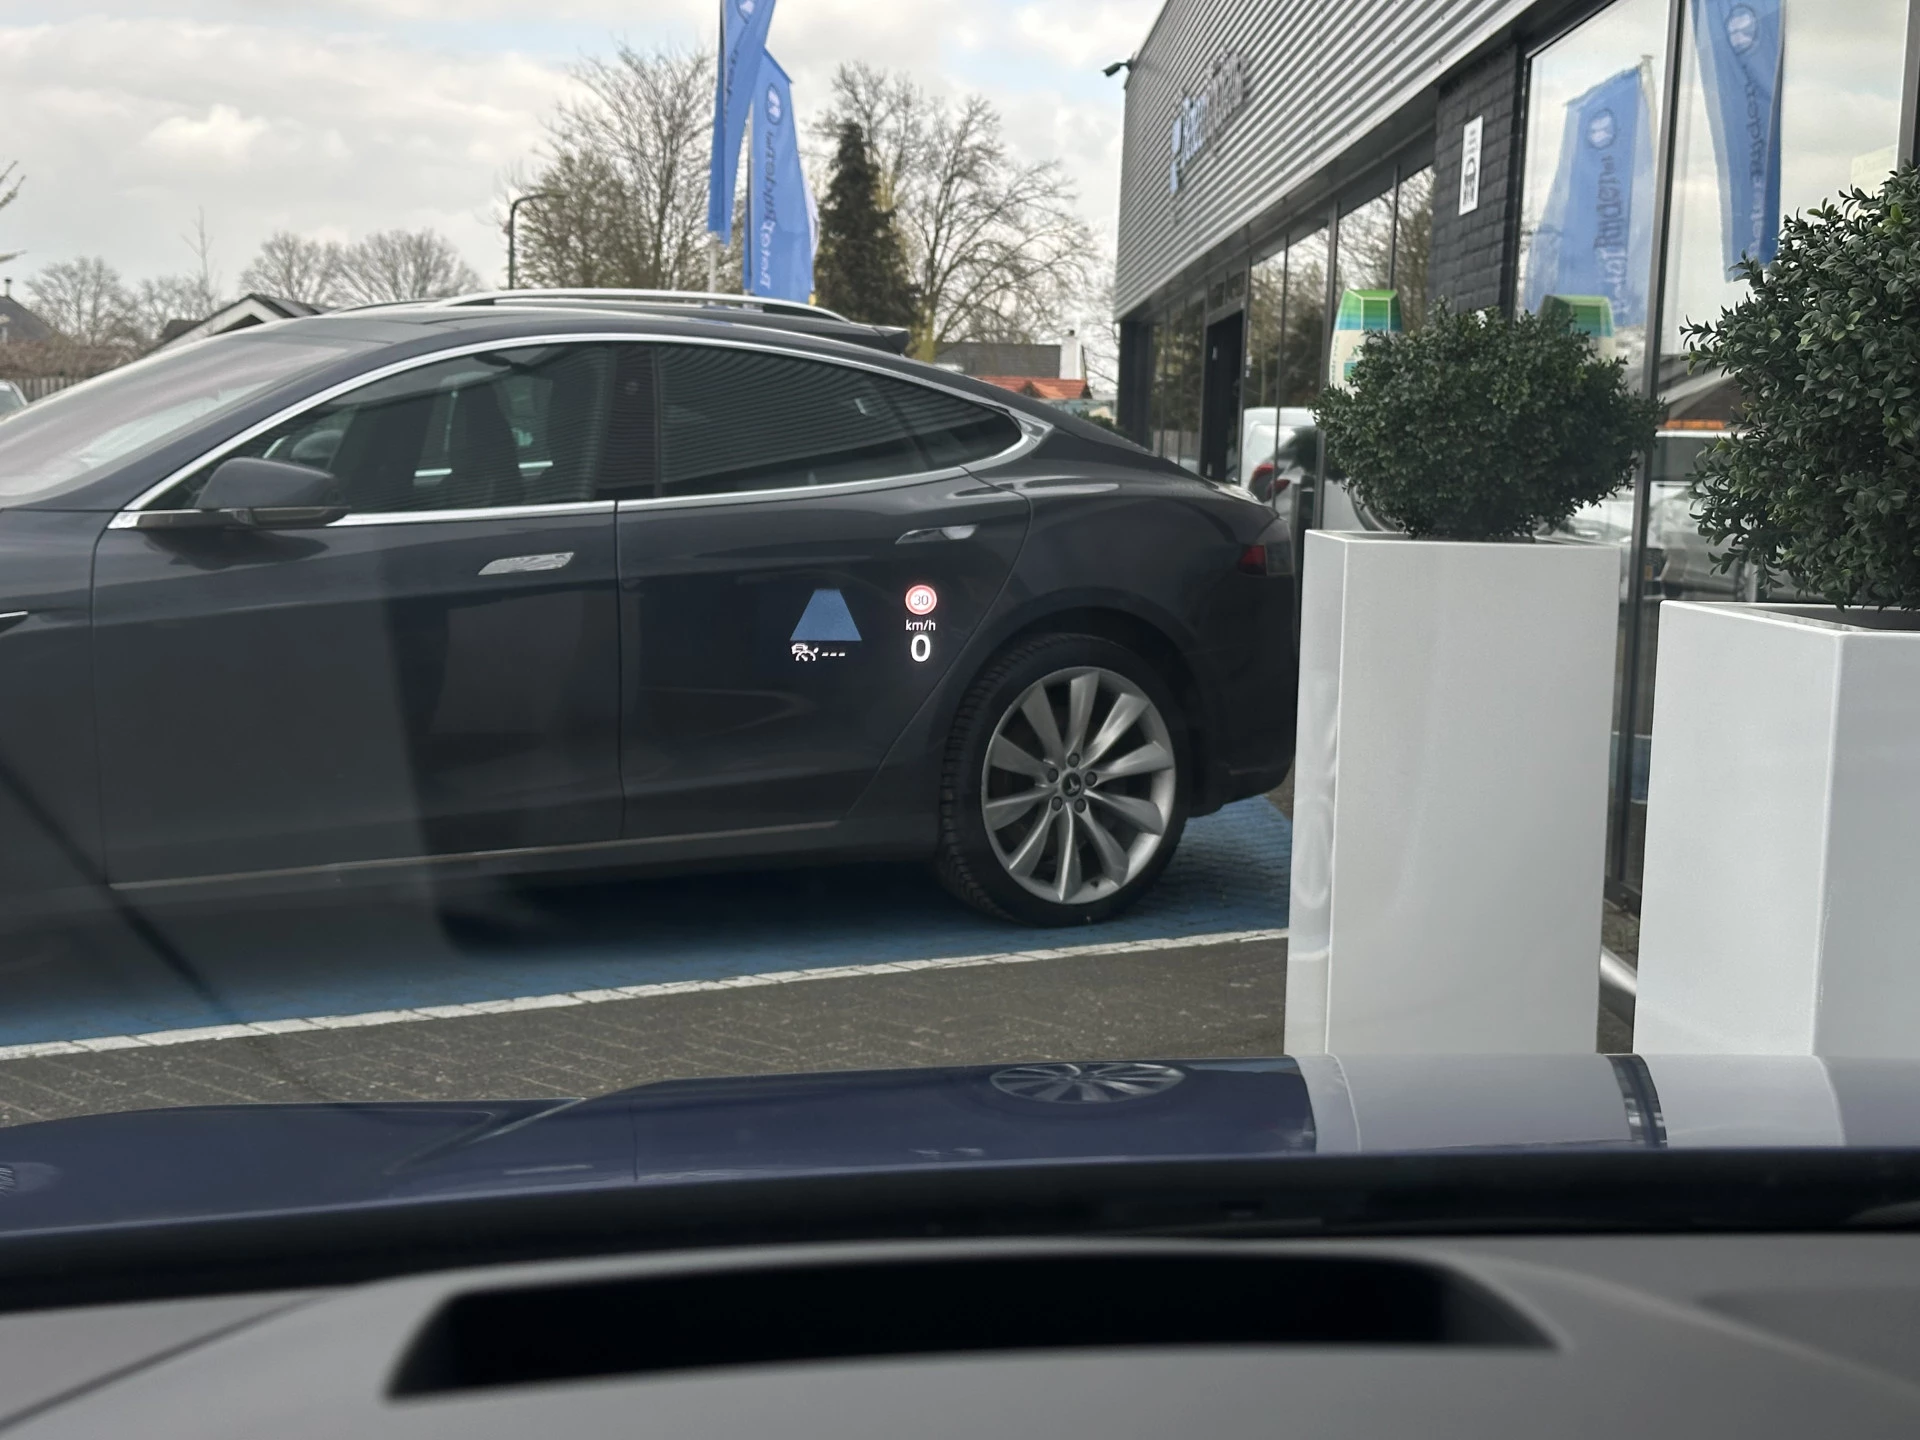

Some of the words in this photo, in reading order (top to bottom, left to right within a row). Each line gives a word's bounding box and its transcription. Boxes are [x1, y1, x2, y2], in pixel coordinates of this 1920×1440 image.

[913, 594, 929, 606] 30
[905, 619, 936, 631] km/h
[911, 634, 931, 662] 0
